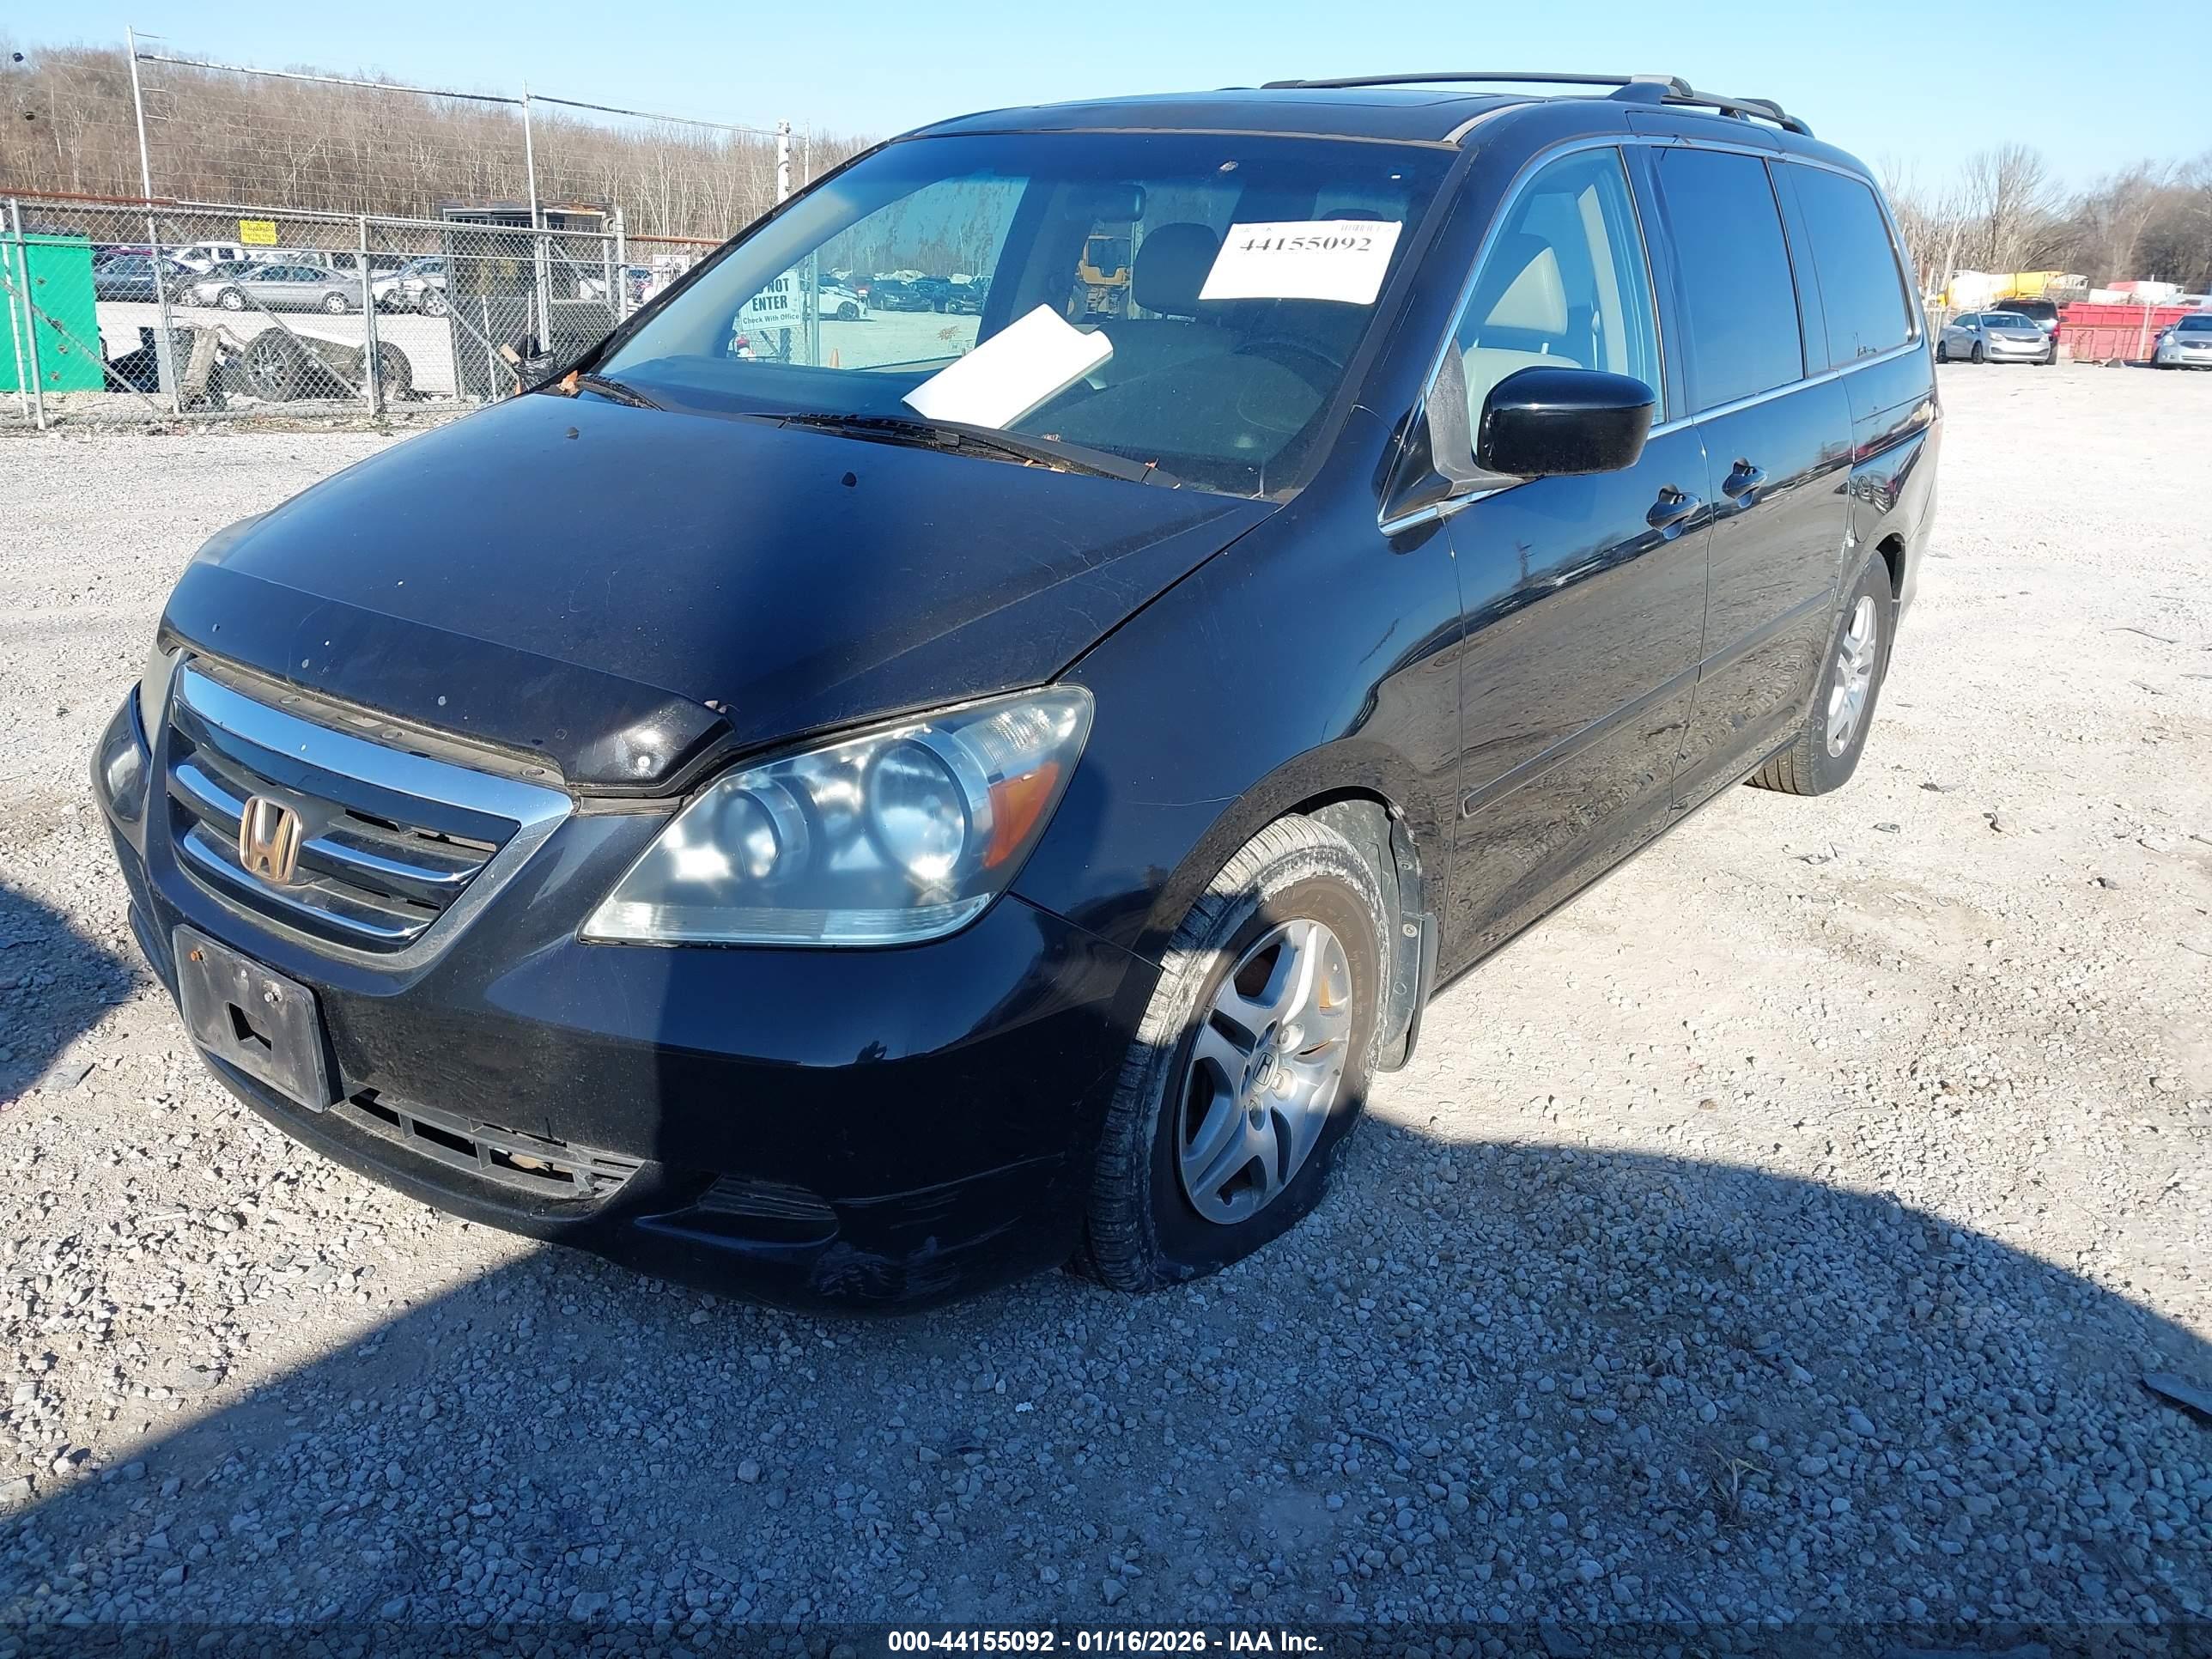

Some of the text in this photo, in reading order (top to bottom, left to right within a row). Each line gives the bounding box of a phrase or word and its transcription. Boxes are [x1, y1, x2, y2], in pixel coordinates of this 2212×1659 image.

[1239, 236, 1372, 252] 44155092
[767, 277, 789, 293] NOT
[752, 295, 788, 312] ENTER
[764, 314, 779, 323] With
